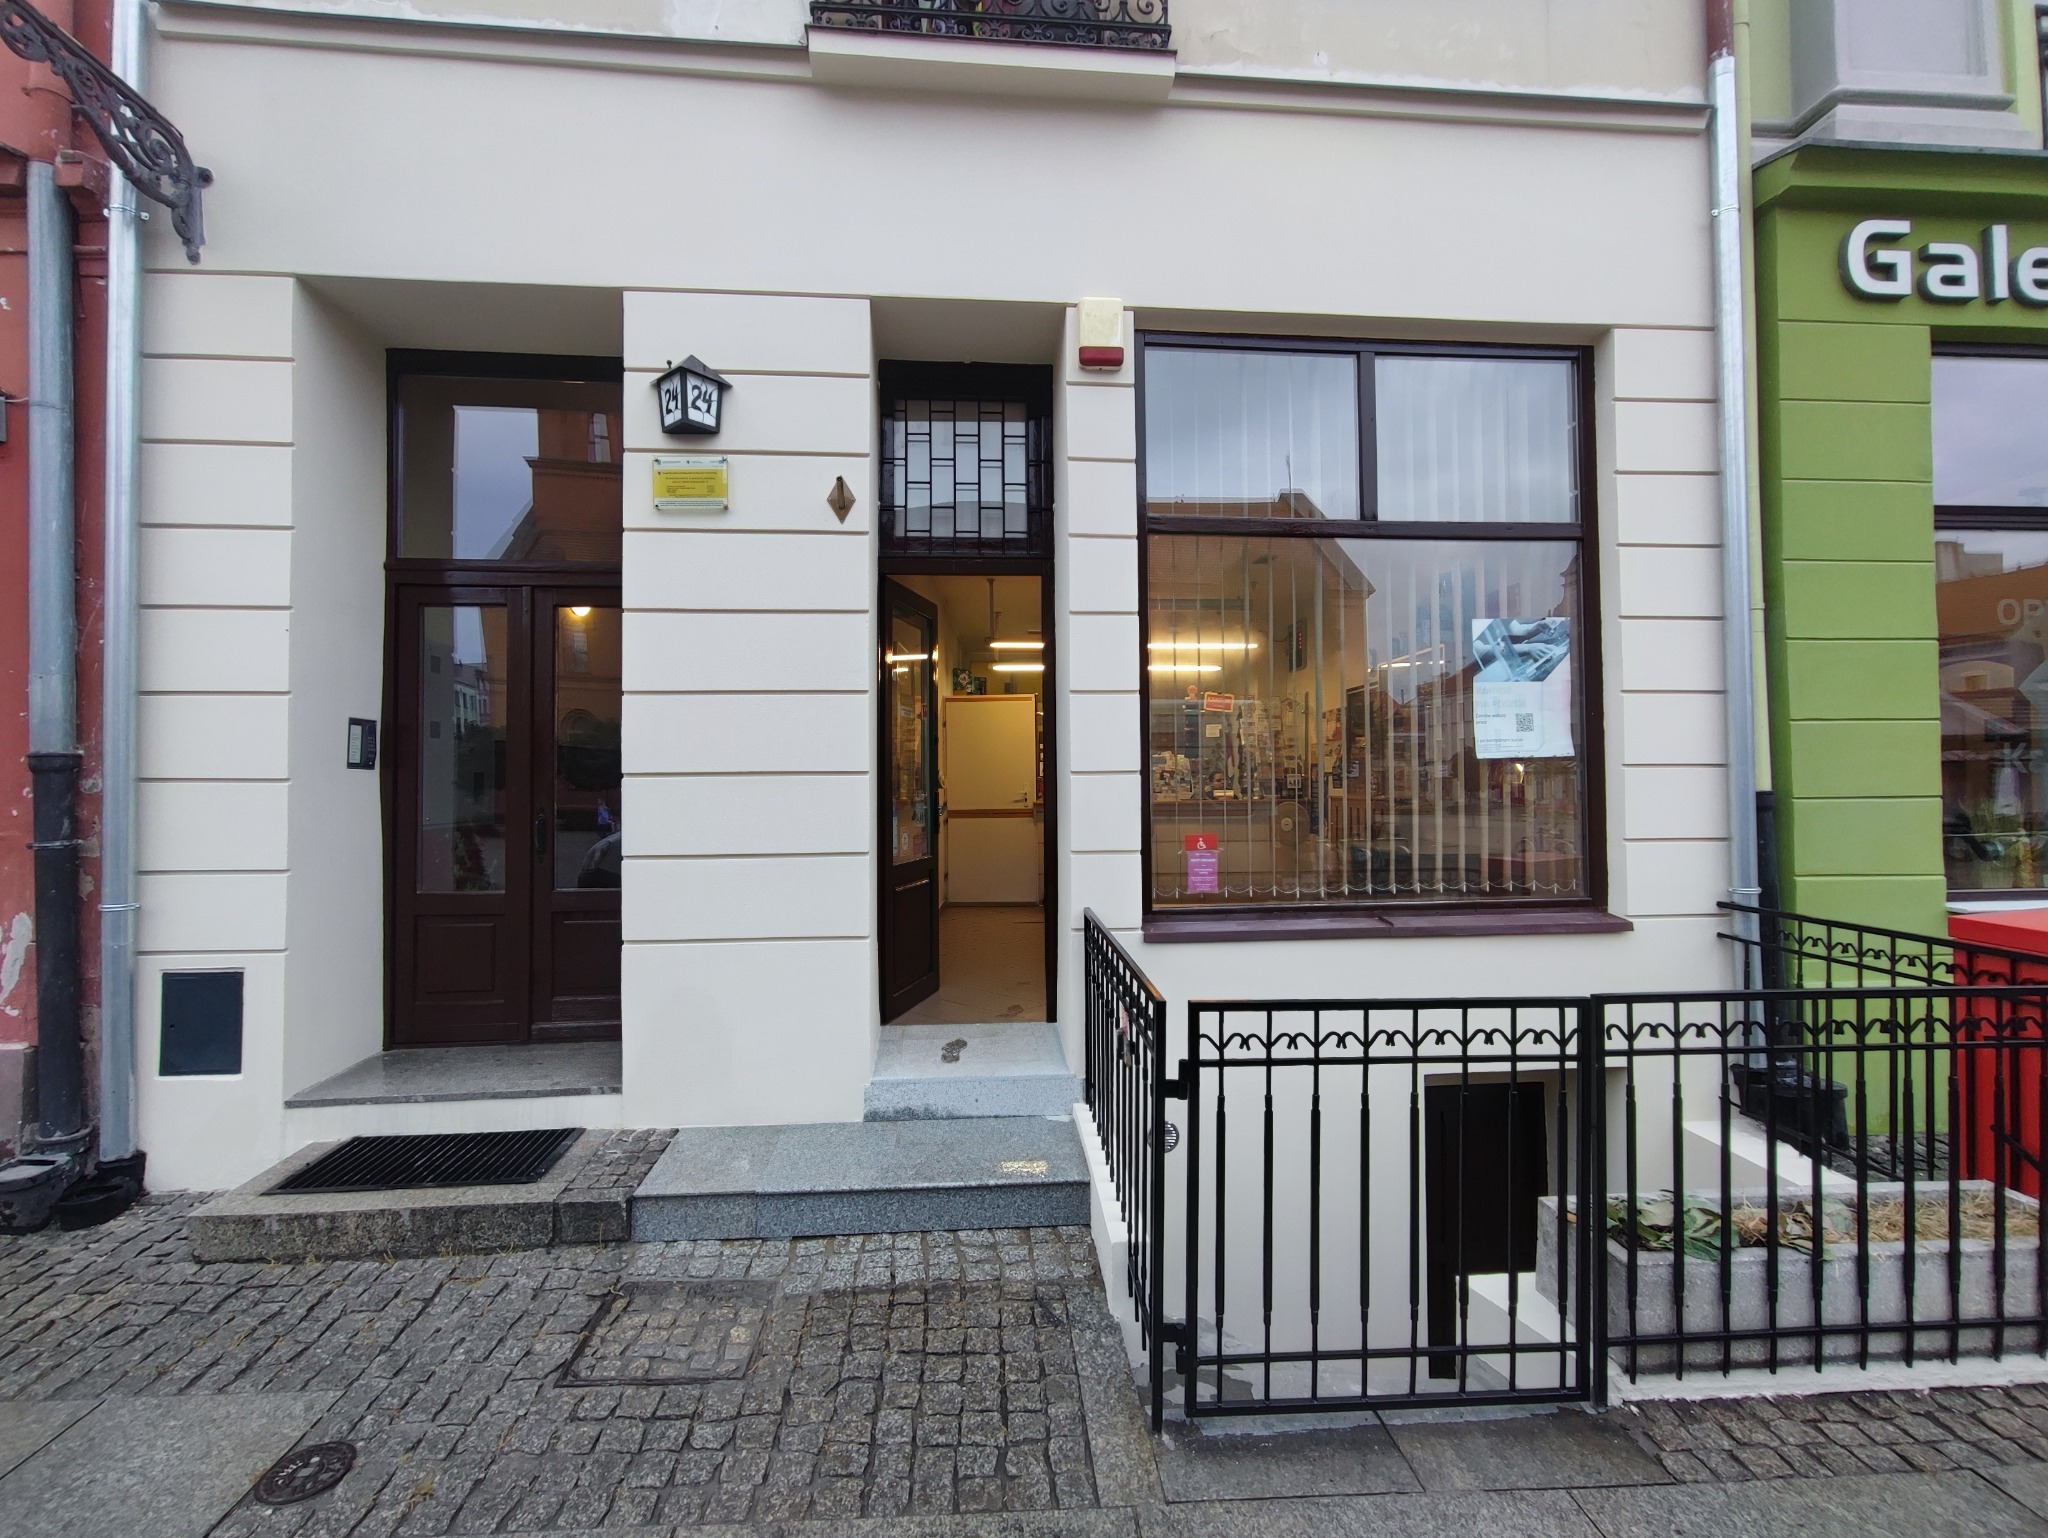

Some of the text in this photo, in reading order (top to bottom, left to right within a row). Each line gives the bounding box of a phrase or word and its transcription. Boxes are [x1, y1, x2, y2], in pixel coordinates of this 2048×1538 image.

[1840, 218, 2048, 304] Gale
[664, 384, 680, 415] 24
[691, 384, 717, 414] 24
[1997, 598, 2048, 626] OP
